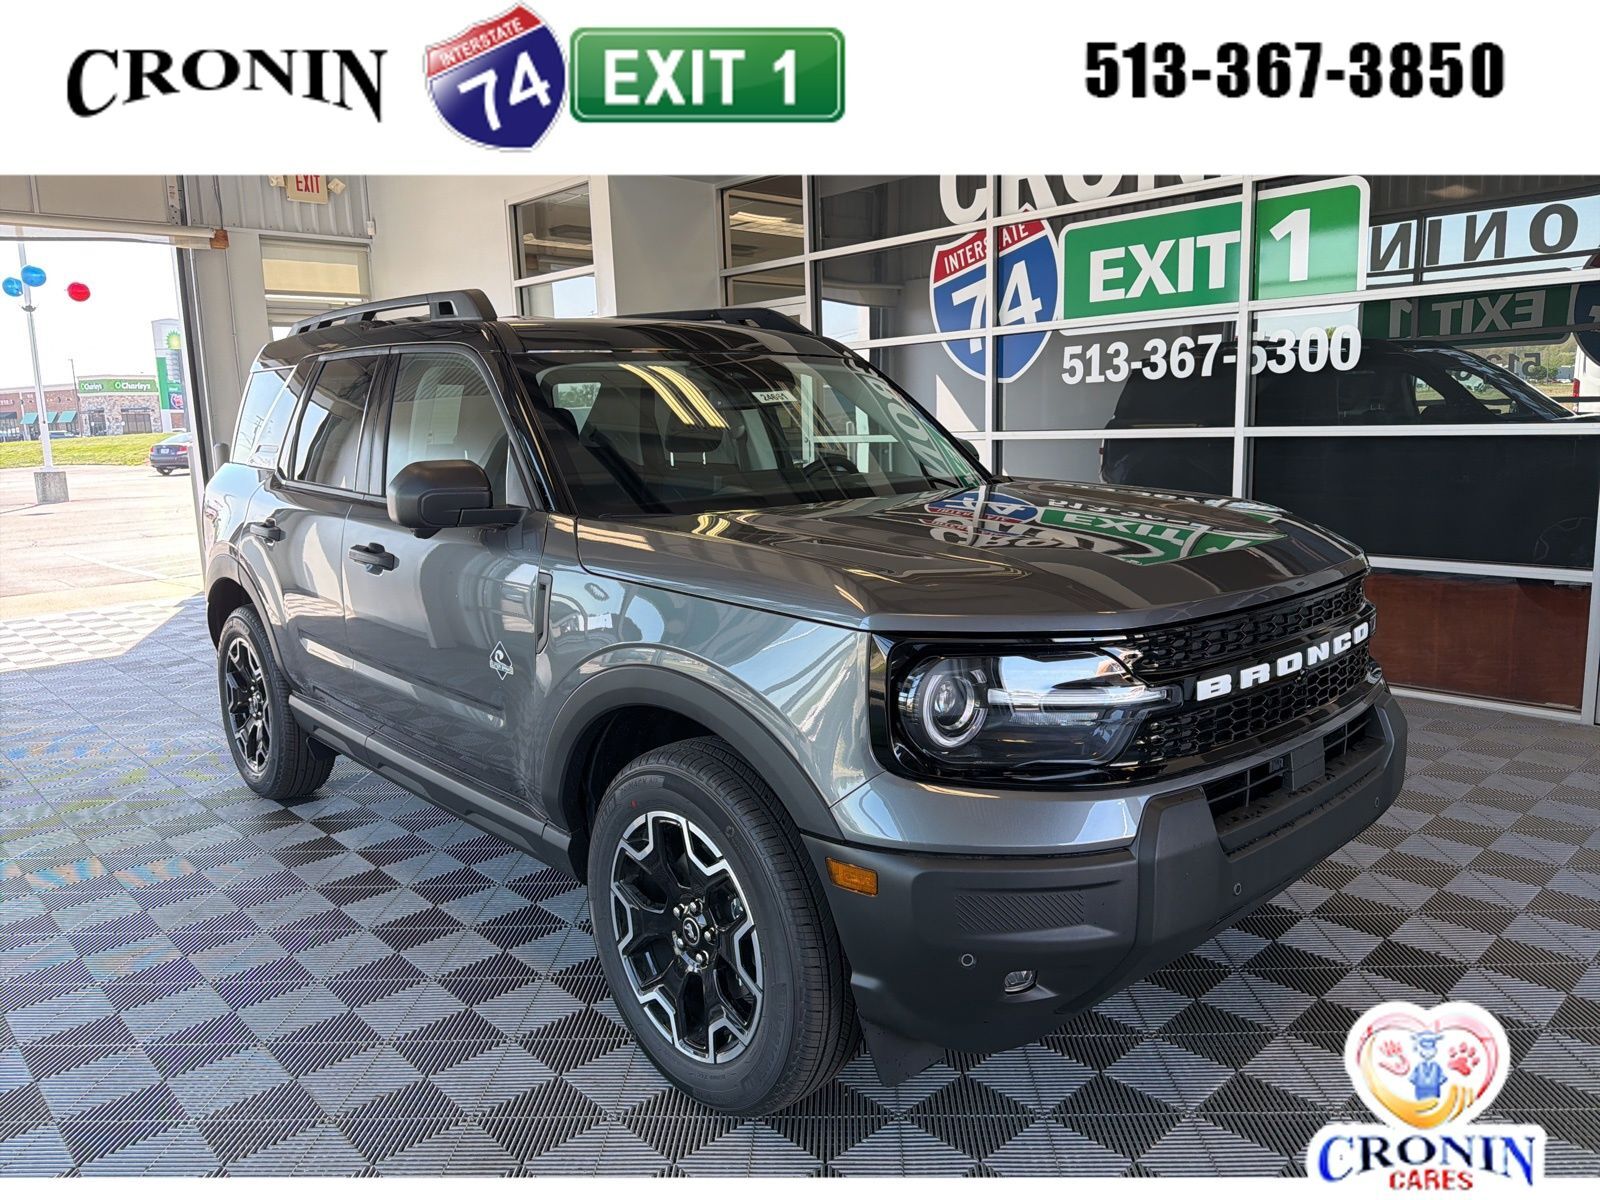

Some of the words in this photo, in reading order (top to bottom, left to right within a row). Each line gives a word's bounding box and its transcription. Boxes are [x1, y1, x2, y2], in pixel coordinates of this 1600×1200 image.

[295, 174, 321, 194] EXIT
[944, 224, 1030, 275] INTERSATE
[1088, 229, 1241, 303] EXIT
[1268, 207, 1311, 283] 1
[951, 259, 1043, 355] 74
[121, 382, 151, 391] Charleys
[1196, 620, 1371, 702] BRONCO
